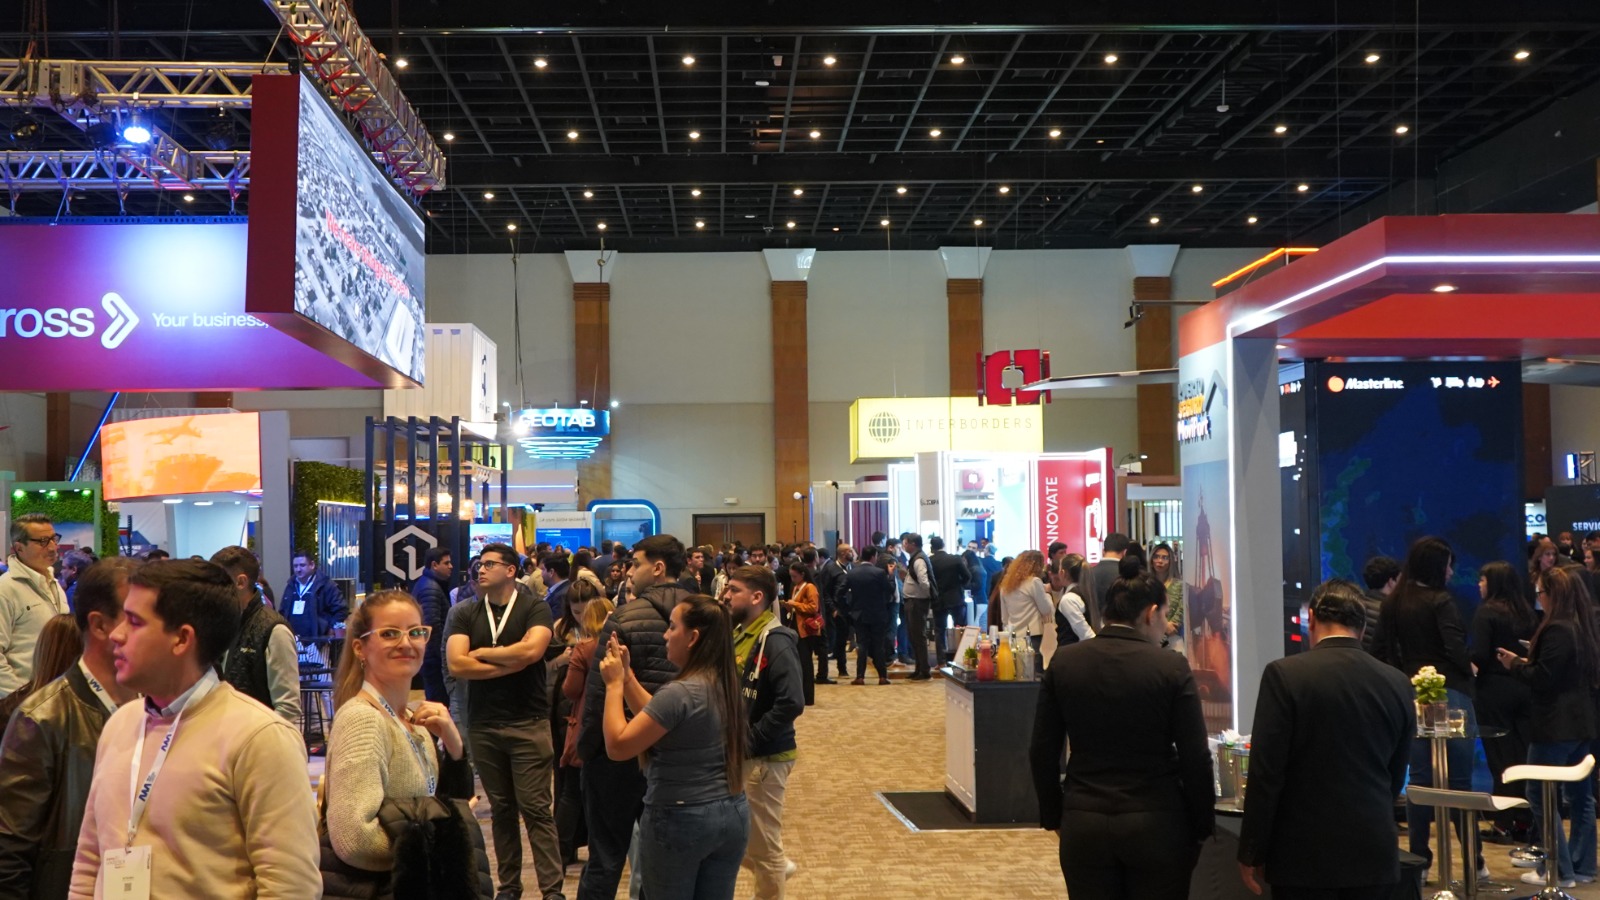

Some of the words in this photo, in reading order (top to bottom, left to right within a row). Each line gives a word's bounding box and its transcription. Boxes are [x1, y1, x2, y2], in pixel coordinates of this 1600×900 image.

[0, 308, 95, 338] ross
[152, 312, 189, 328] Your
[1345, 377, 1405, 390] Masterline
[519, 413, 596, 428] GEOTAB
[906, 417, 1033, 431] INTERBORDERS
[1045, 476, 1059, 552] NNOVATE
